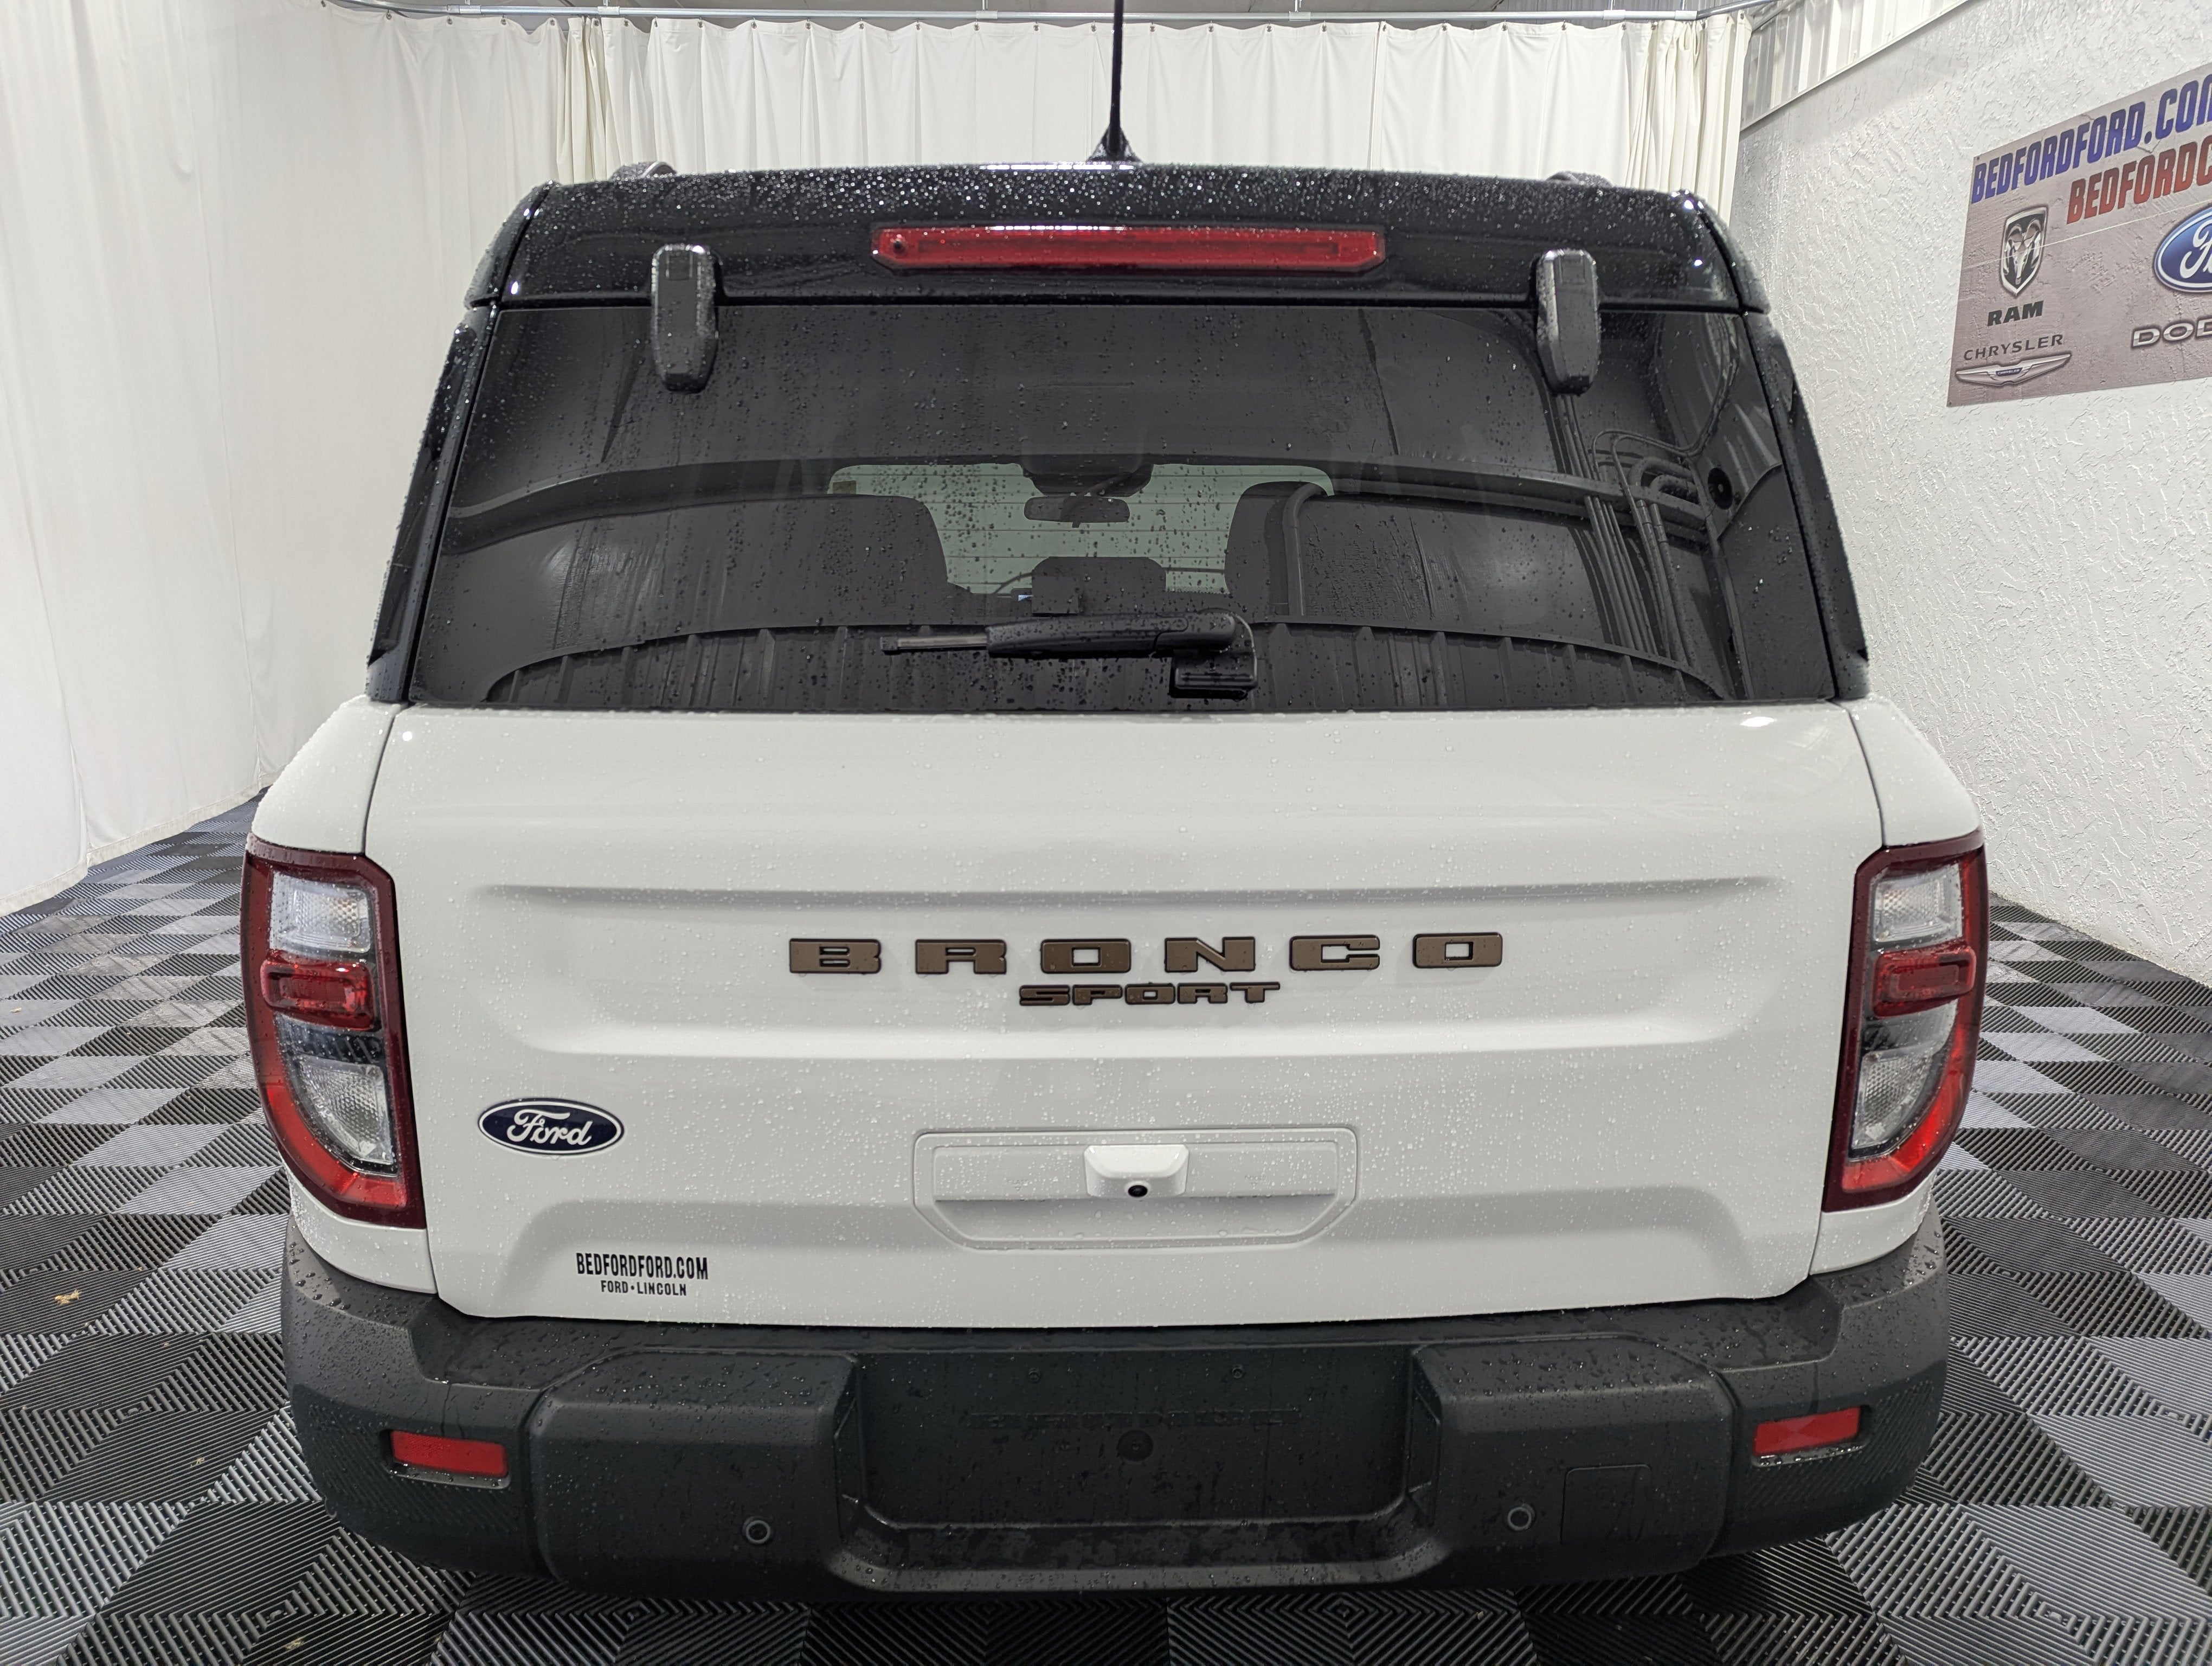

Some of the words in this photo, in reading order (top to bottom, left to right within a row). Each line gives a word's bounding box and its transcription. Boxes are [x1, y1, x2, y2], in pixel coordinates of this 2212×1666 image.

[1987, 300, 2044, 326] RAM
[1964, 334, 2063, 361] CHRYSLER
[789, 932, 1503, 975] BRONCO
[1018, 982, 1281, 1007] SPORT
[506, 1108, 593, 1146] Ford
[576, 1252, 709, 1280] BEDFORDFORD.COM
